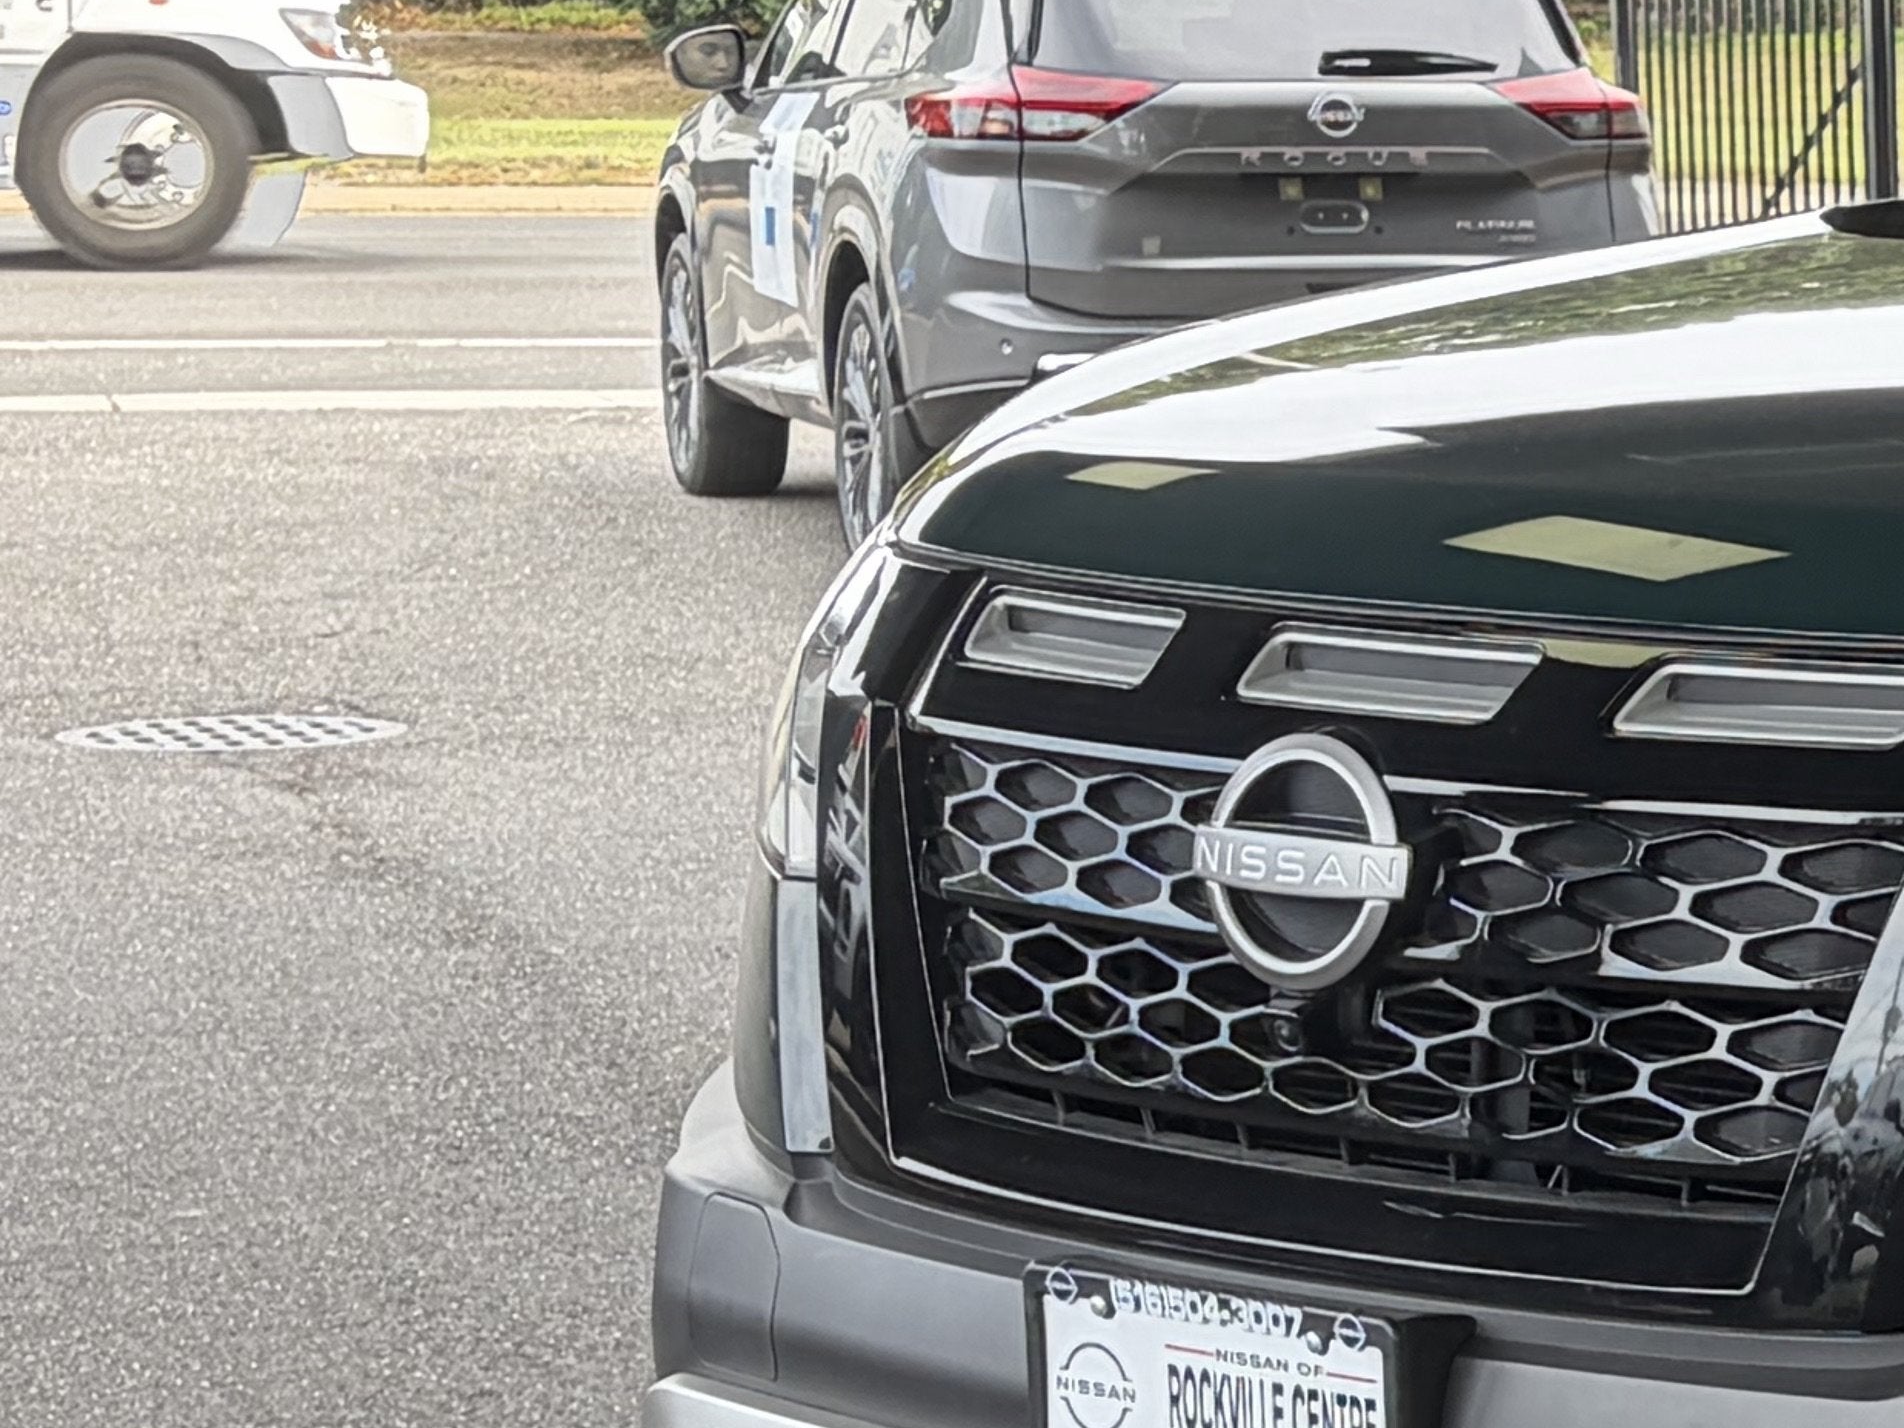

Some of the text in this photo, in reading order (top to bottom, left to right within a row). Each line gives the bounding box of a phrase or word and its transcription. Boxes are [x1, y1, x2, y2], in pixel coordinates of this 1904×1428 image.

[1197, 836, 1398, 890] NISSAN
[1215, 1348, 1324, 1378] NISSAN OF
[1056, 1375, 1136, 1404] NISSAN
